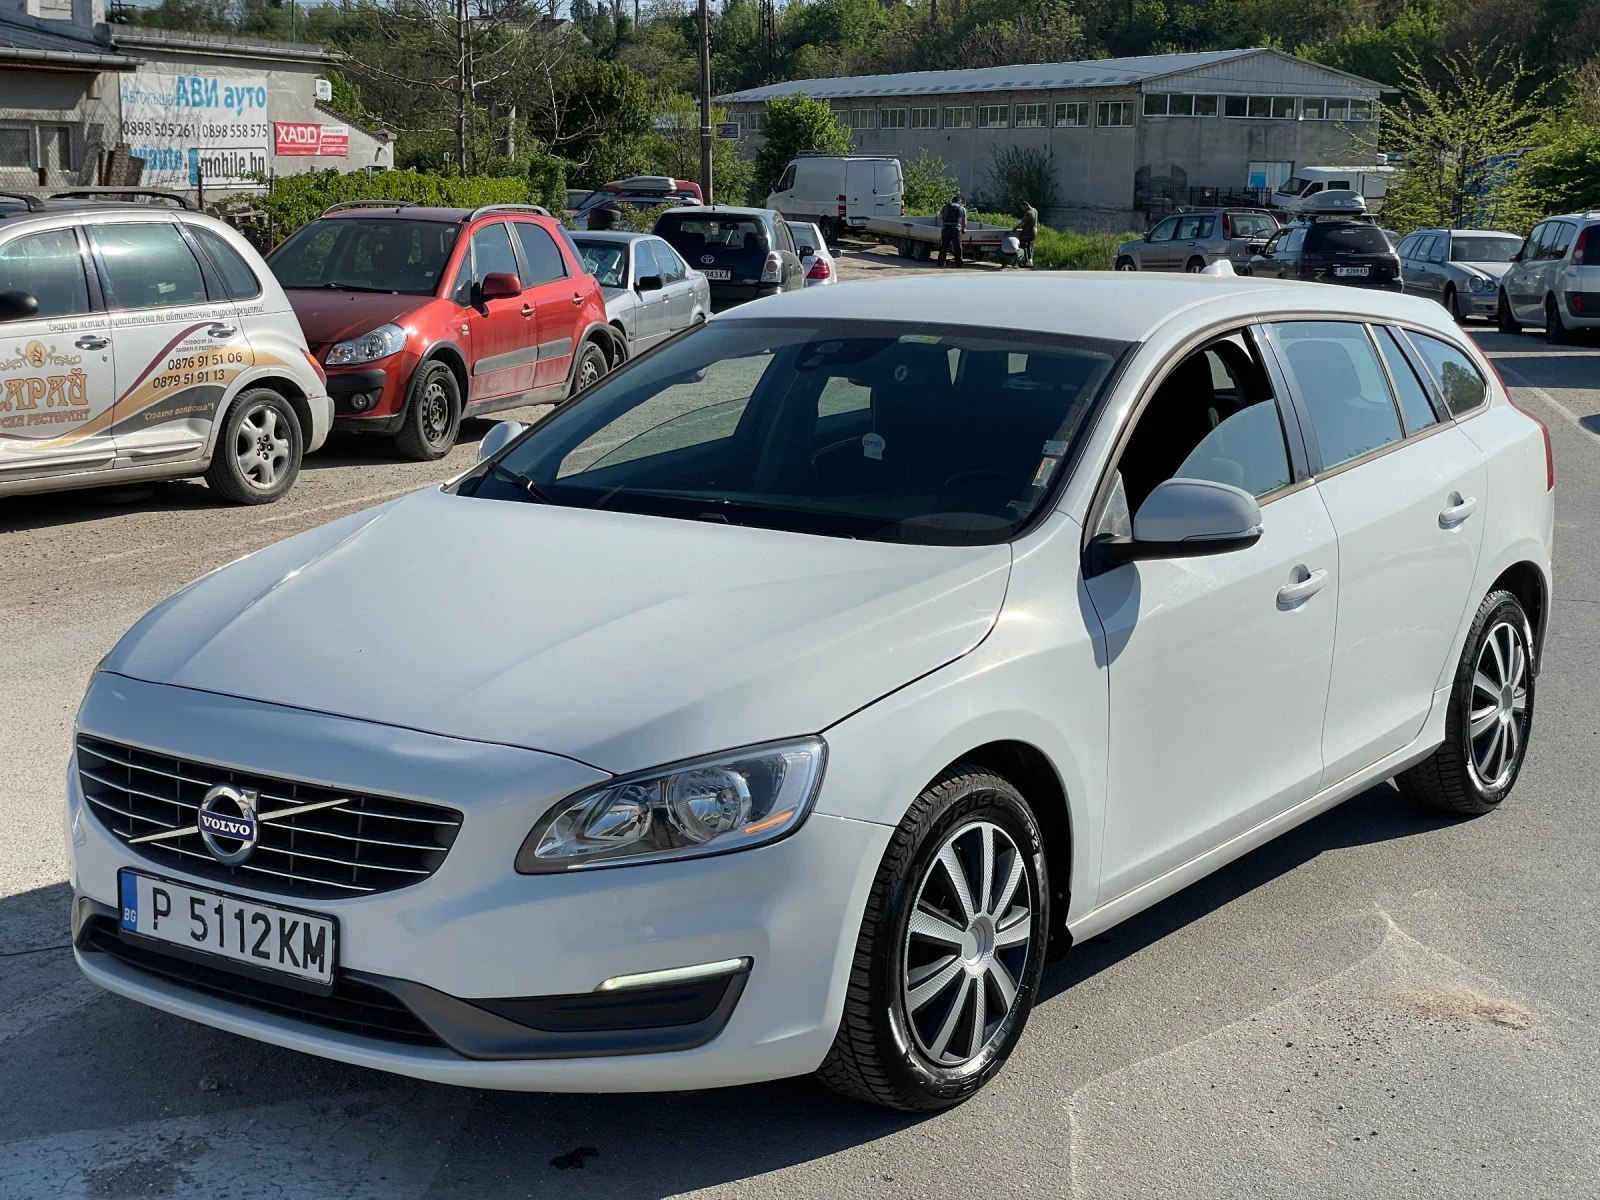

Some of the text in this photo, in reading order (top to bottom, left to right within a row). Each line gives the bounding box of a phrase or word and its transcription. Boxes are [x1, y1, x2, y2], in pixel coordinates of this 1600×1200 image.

[176, 75, 219, 107] АВИ
[224, 86, 266, 116] ауто
[123, 121, 151, 136] 0898
[154, 122, 174, 137] 505
[202, 124, 228, 138] 0898
[230, 124, 248, 138] 558
[250, 124, 267, 138] 575
[201, 151, 265, 178] mobilebg
[168, 352, 243, 370] 0876 91 51 06
[153, 369, 225, 388] 0879 51 91 13
[0, 368, 88, 412] АРАЙ
[0, 414, 25, 429] СКИ
[201, 814, 251, 836] VOLVO
[124, 907, 137, 923] BG
[153, 887, 326, 974] P 5112KM
